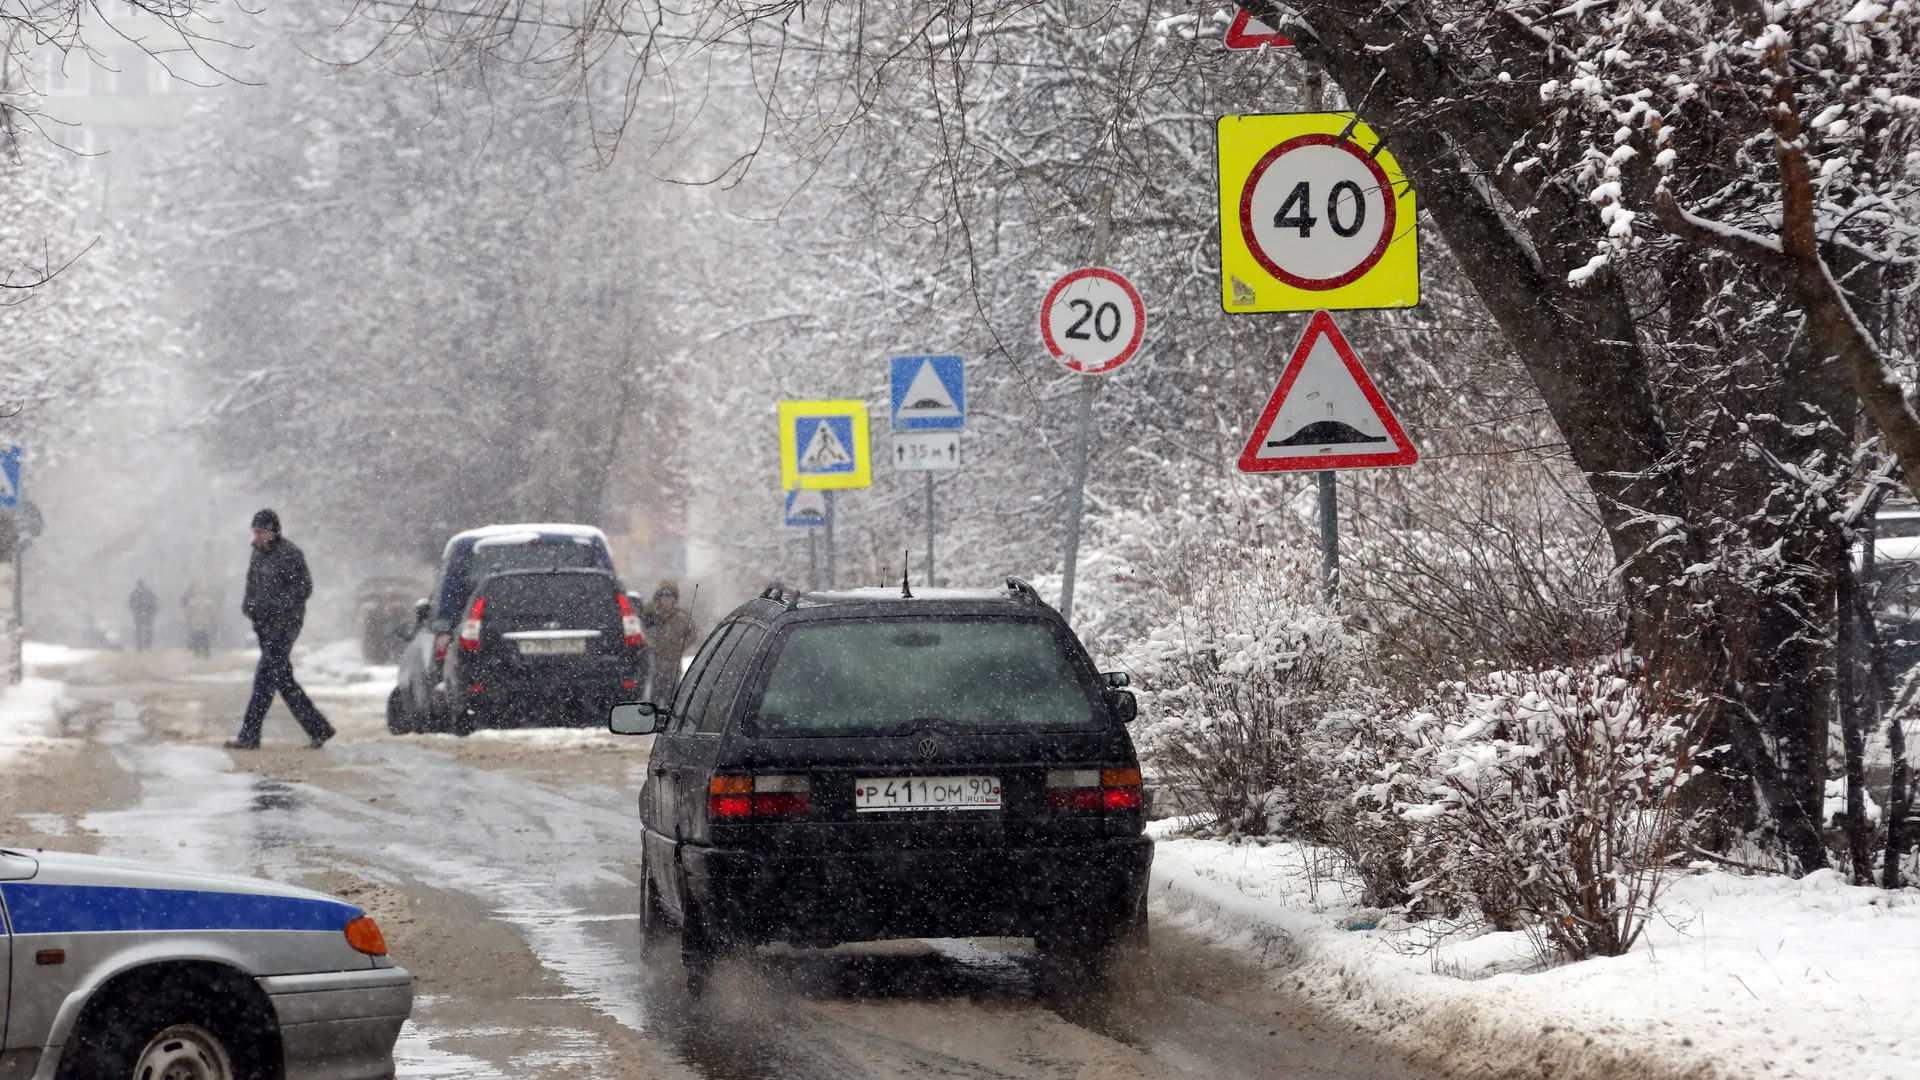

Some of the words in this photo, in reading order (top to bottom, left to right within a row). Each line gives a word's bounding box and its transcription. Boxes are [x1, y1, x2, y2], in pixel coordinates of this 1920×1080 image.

[1273, 179, 1366, 238] 40
[1065, 298, 1121, 342] 20
[909, 443, 928, 460] 35
[969, 778, 992, 795] 90
[967, 795, 985, 803] RUS
